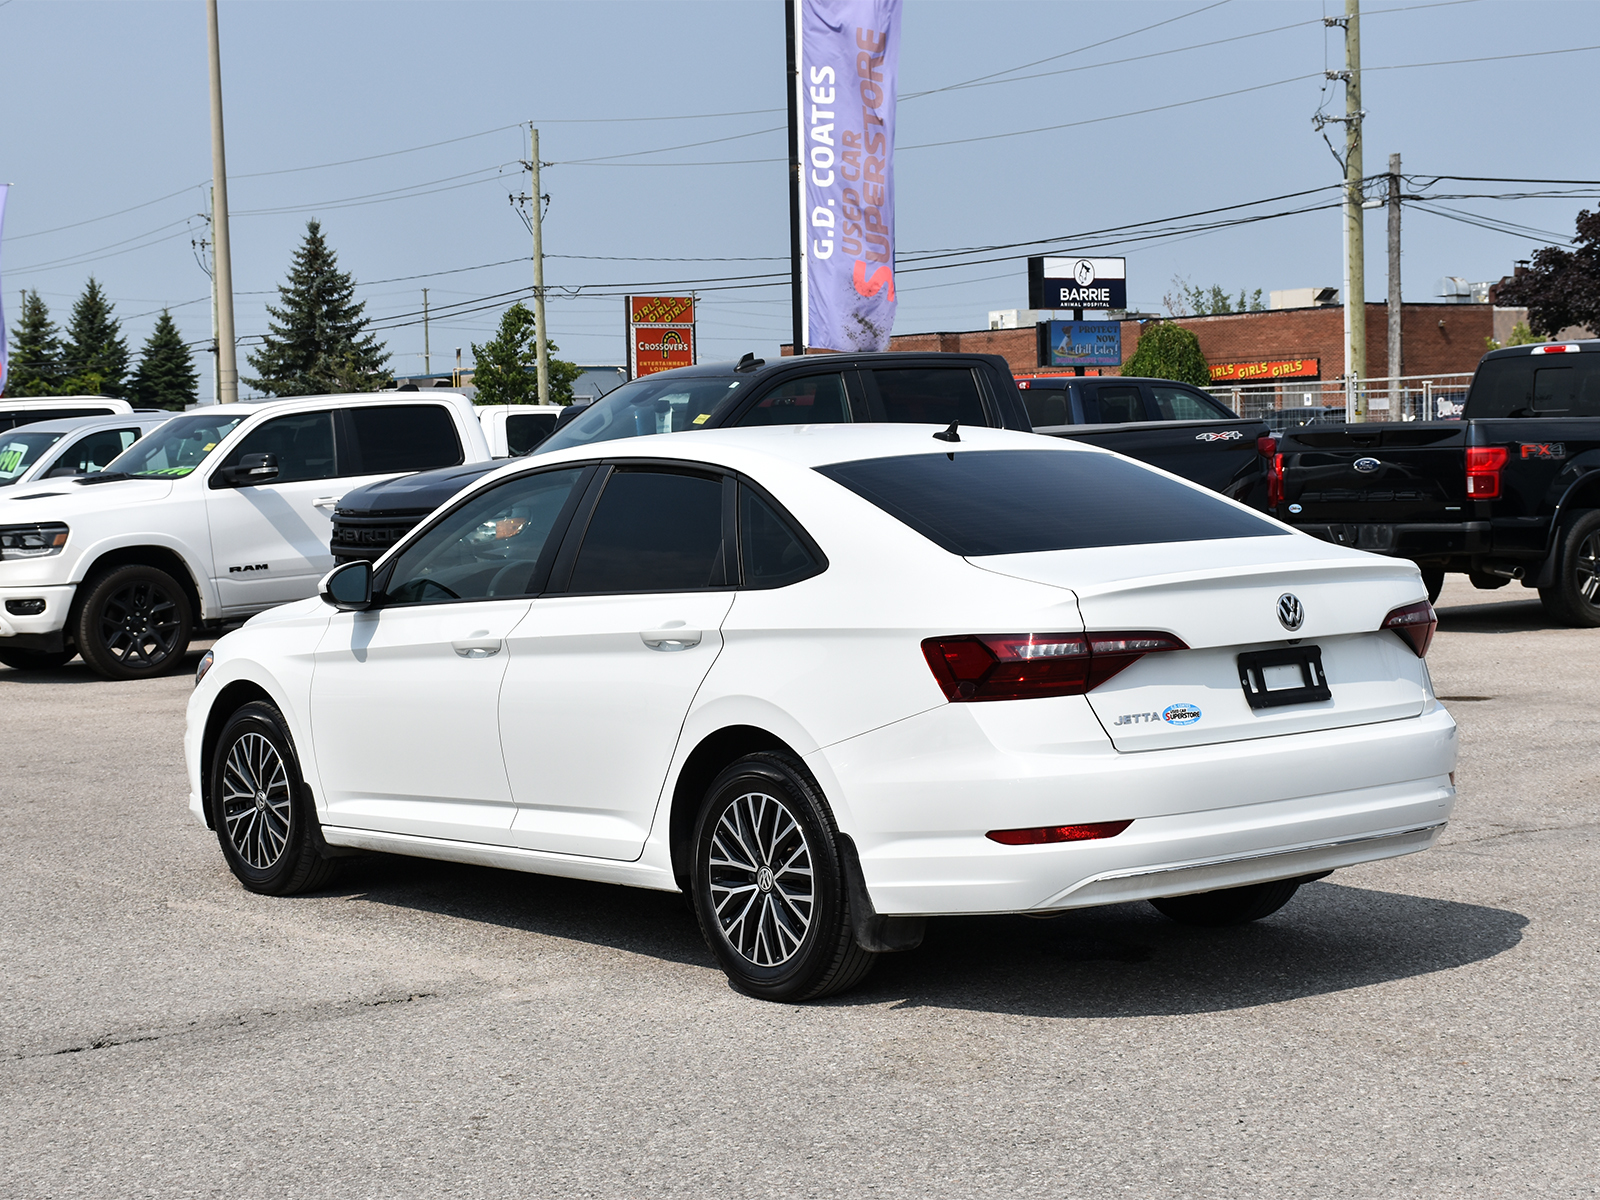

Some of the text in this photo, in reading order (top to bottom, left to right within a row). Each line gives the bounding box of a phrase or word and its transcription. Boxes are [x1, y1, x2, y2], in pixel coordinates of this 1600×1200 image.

[809, 65, 836, 260] G.D. COATES
[852, 26, 896, 302] SUPERSTORE
[841, 130, 863, 256] USED CAR
[1060, 288, 1110, 301] BARRIE
[633, 297, 661, 323] GIRLS
[648, 297, 677, 323] GIRLS
[664, 297, 692, 323] GIRLS
[1078, 325, 1119, 334] PROTECT
[1238, 362, 1269, 378] GIRLS
[1272, 360, 1303, 377] GIRLS
[1519, 442, 1567, 460] FX4
[332, 528, 406, 544] CHEVROL
[229, 563, 269, 573] RAM
[1113, 711, 1161, 726] JETTA
